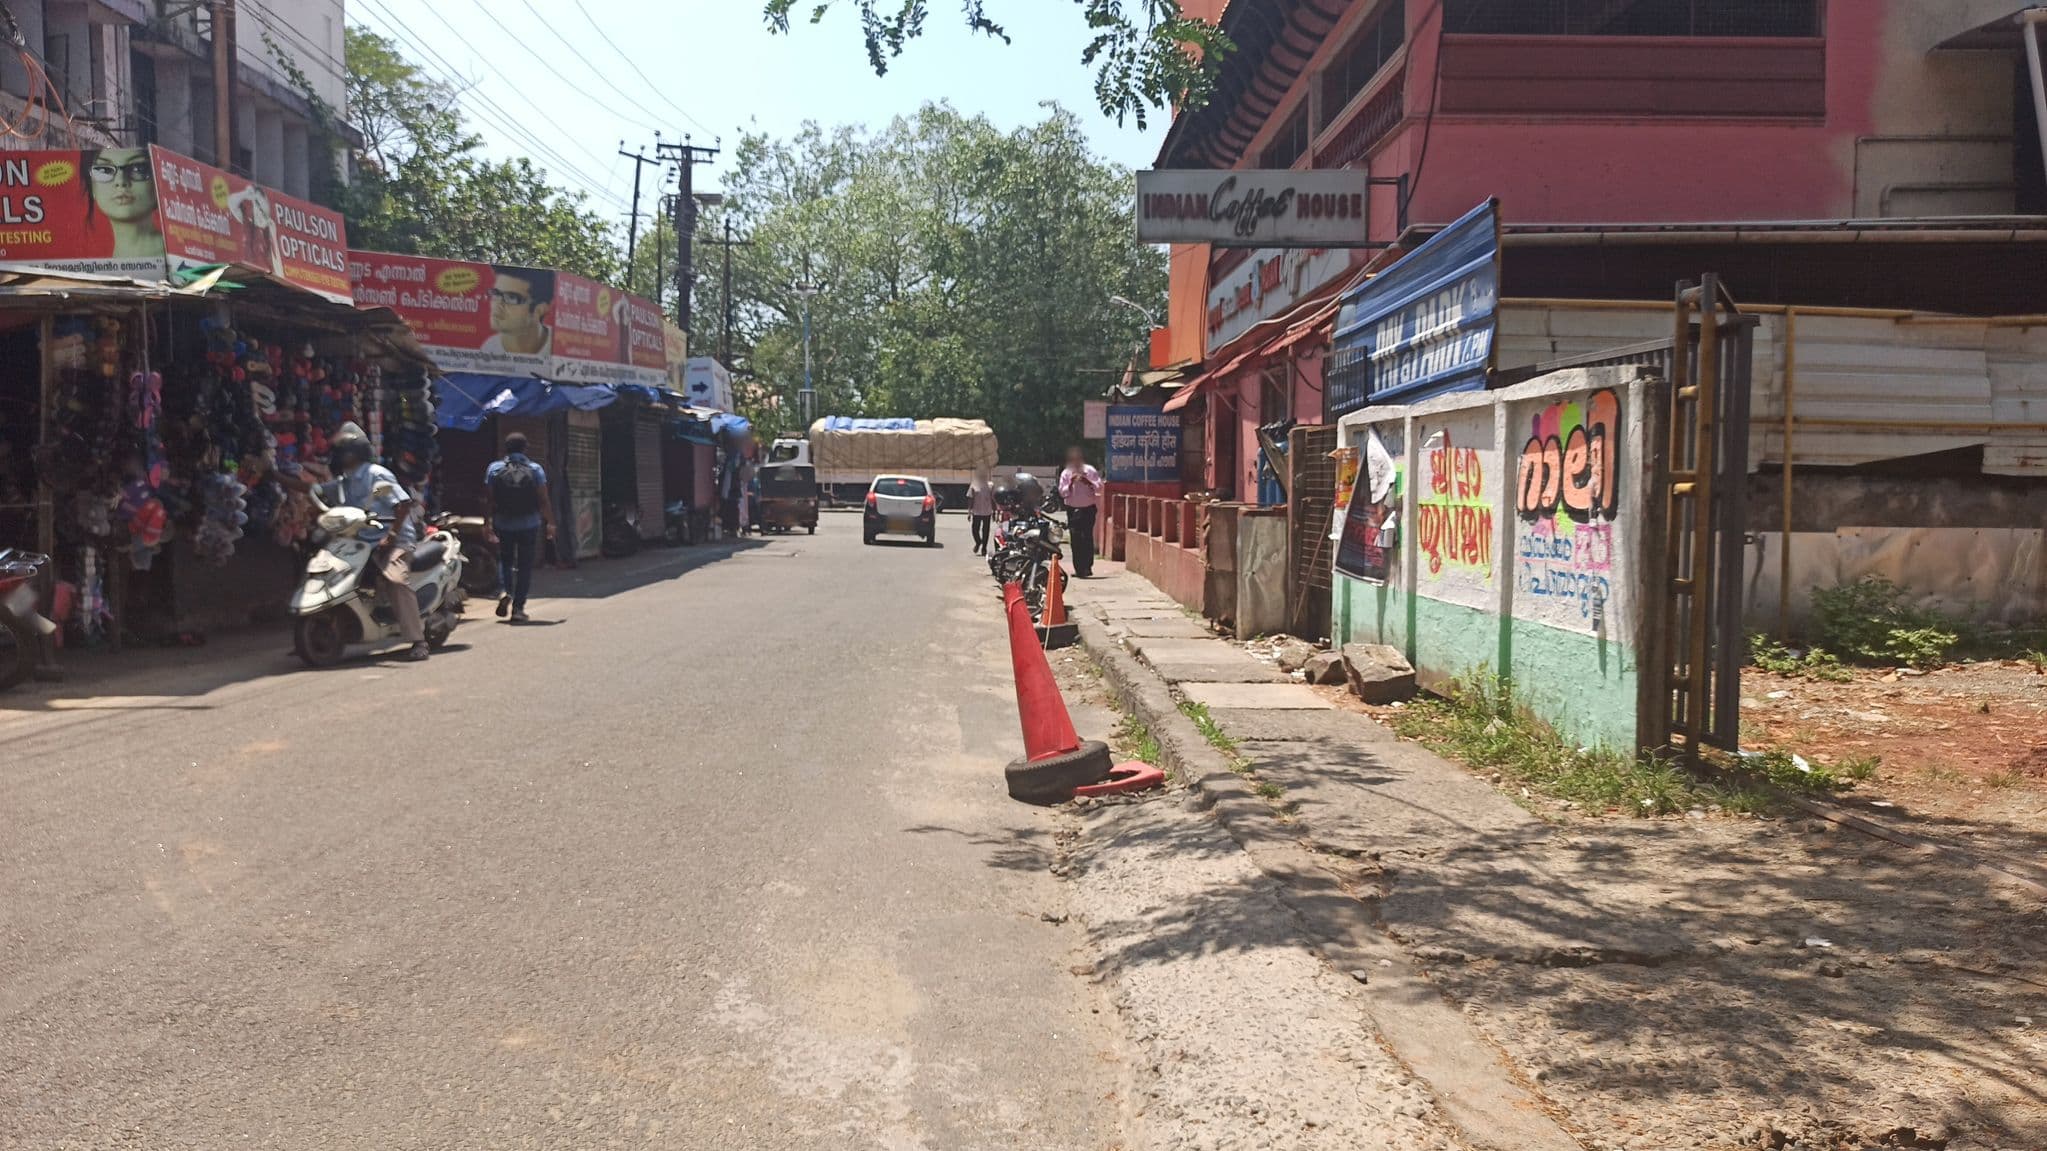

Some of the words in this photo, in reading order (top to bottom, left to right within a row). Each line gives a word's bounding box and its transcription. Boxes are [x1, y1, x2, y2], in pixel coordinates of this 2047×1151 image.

[0, 195, 44, 224] LS
[1144, 193, 1208, 220] INDIAN
[1209, 175, 1295, 237] Coffee
[1297, 193, 1362, 219] HOUSE
[275, 203, 338, 242] PAULSON
[0, 230, 52, 245] TESTING
[280, 235, 345, 272] OPTICALS
[632, 328, 663, 352] OPTICALS
[1109, 415, 1132, 427] INDIAN
[1132, 415, 1157, 427] COFFEE
[1158, 415, 1180, 427] HOUSE
